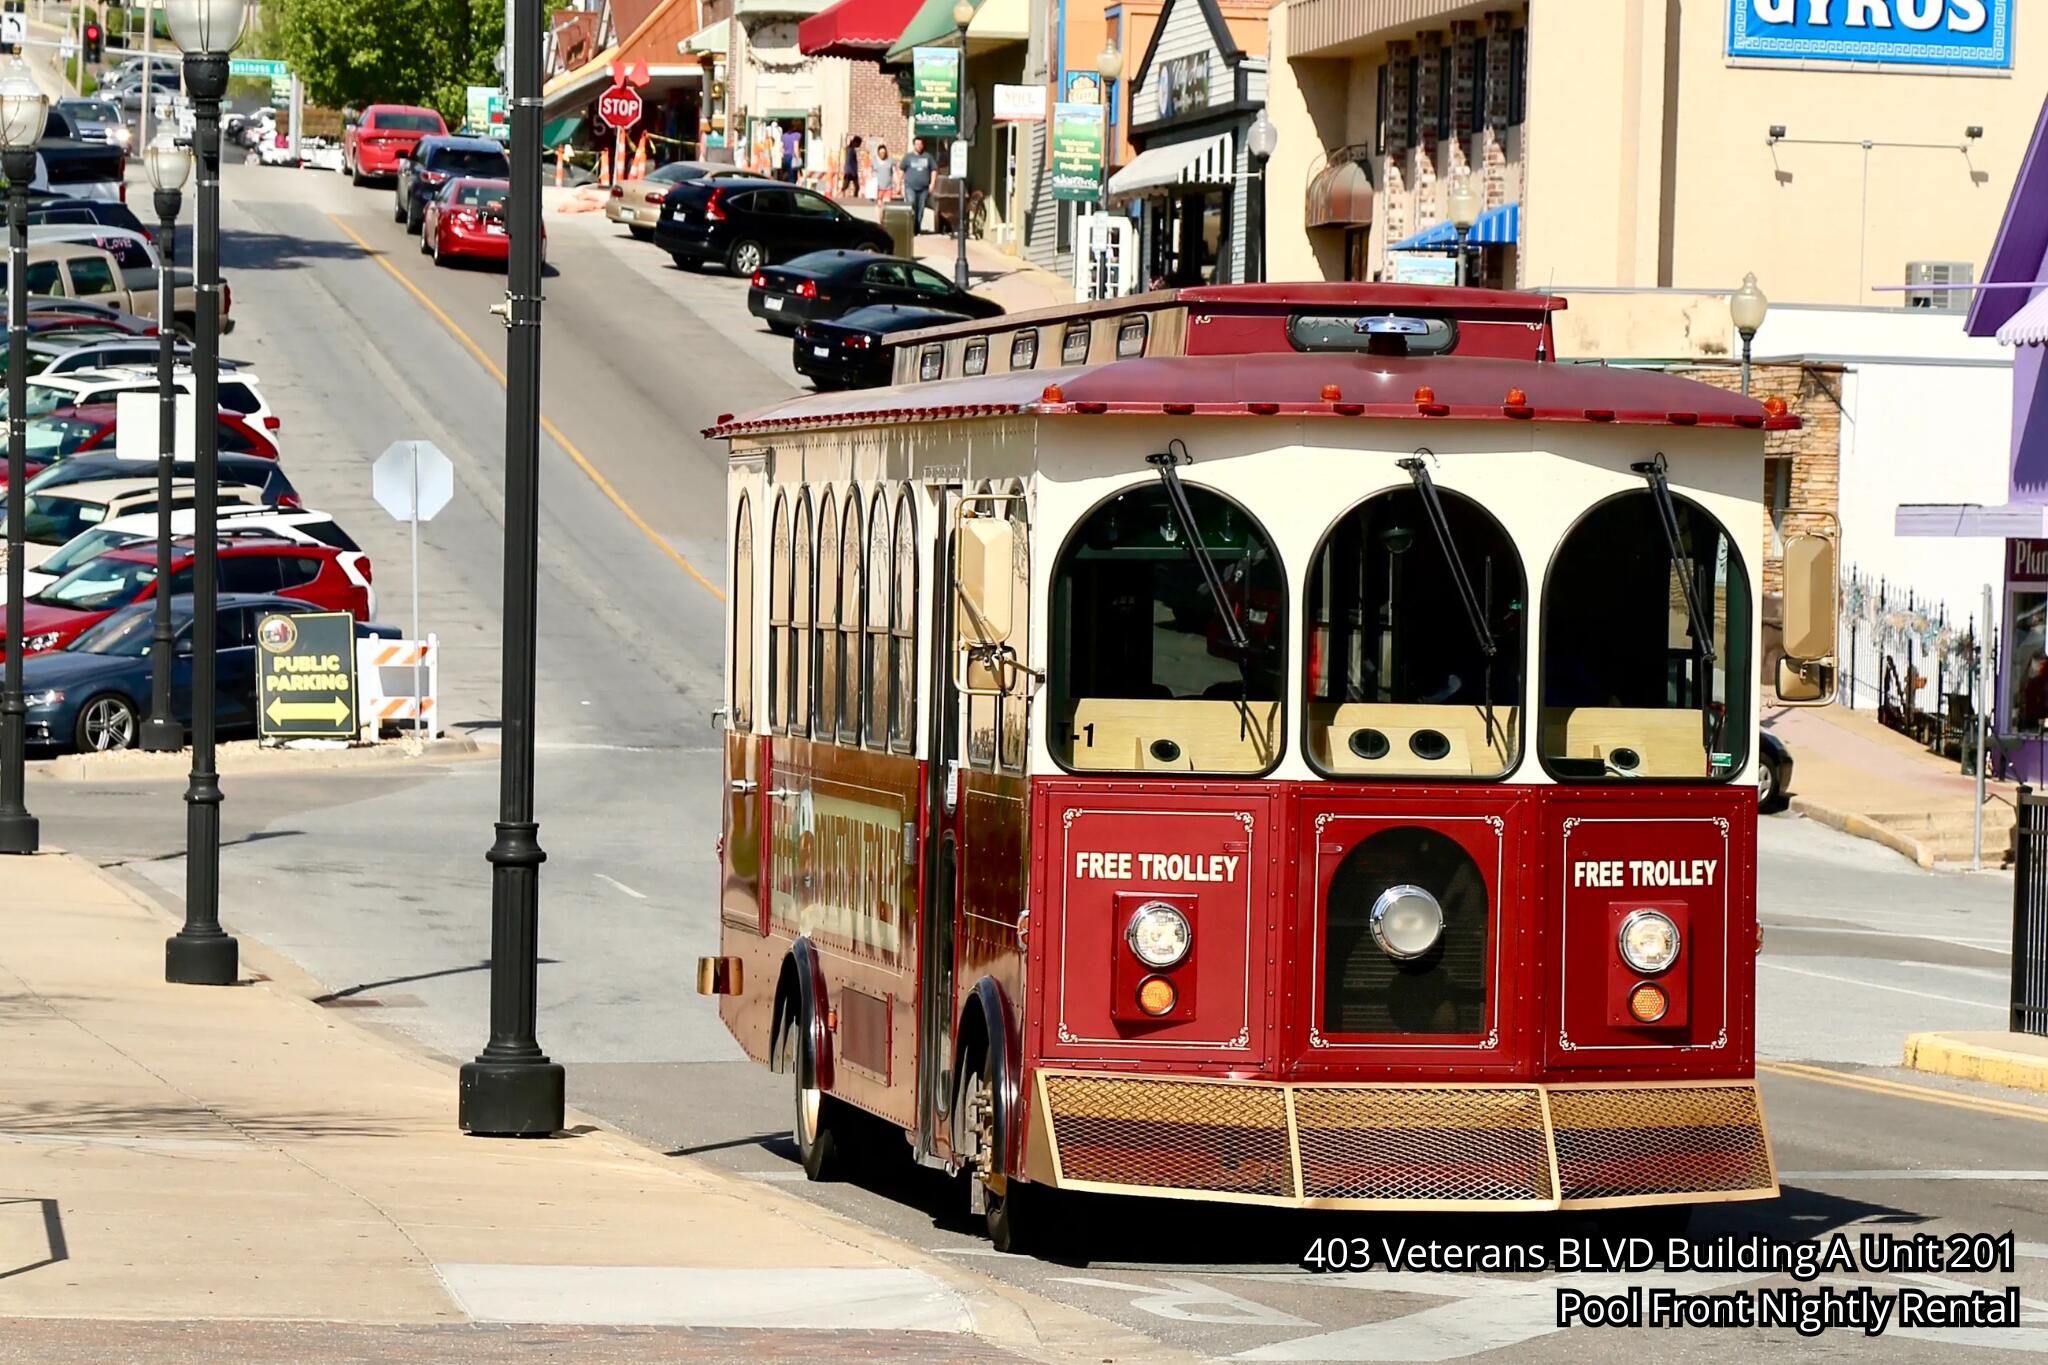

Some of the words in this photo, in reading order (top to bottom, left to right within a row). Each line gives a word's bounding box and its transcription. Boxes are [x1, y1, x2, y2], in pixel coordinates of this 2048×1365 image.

[602, 98, 639, 117] STOP
[273, 655, 340, 672] PUBLIC
[266, 673, 349, 691] PARKING
[1076, 851, 1132, 879] FREE
[1138, 853, 1239, 882] TROLLEY
[1574, 861, 1624, 887] FREE
[1629, 859, 1717, 886] TROLLEY
